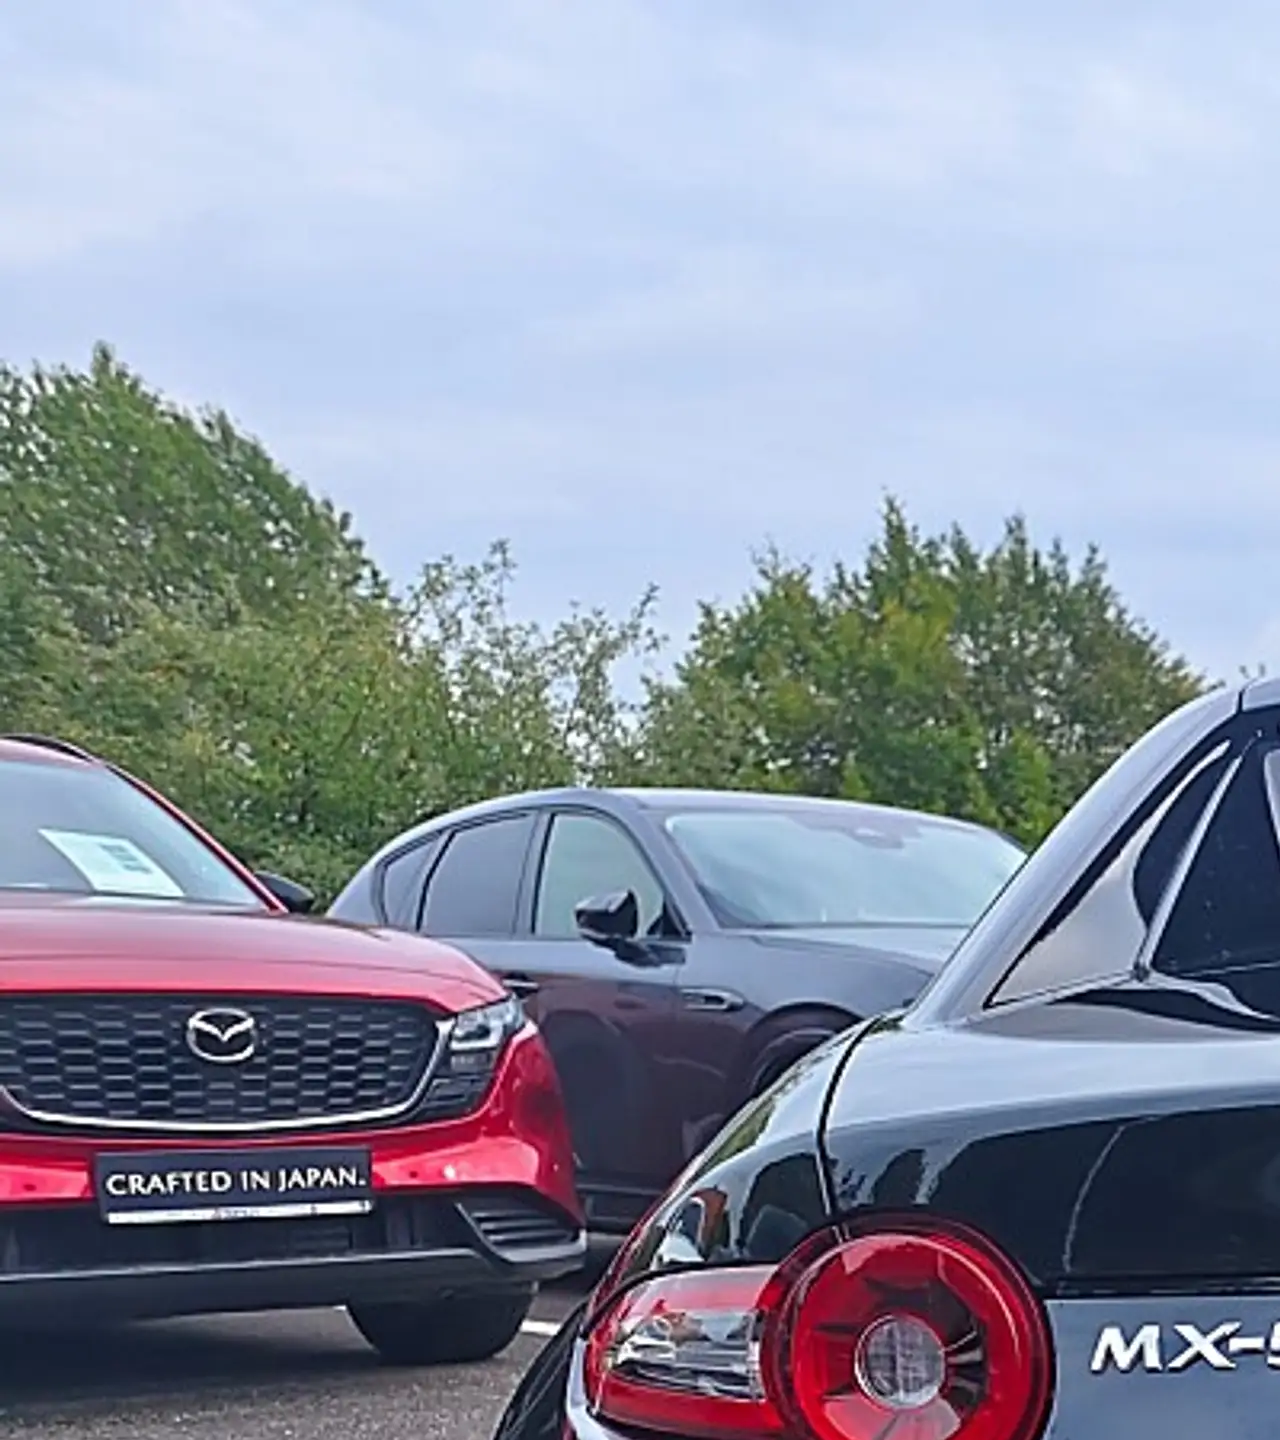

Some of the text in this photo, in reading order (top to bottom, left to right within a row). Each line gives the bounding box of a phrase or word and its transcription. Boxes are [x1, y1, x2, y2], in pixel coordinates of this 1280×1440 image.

[105, 1166, 367, 1195] CRAFTED IN JAPAN.
